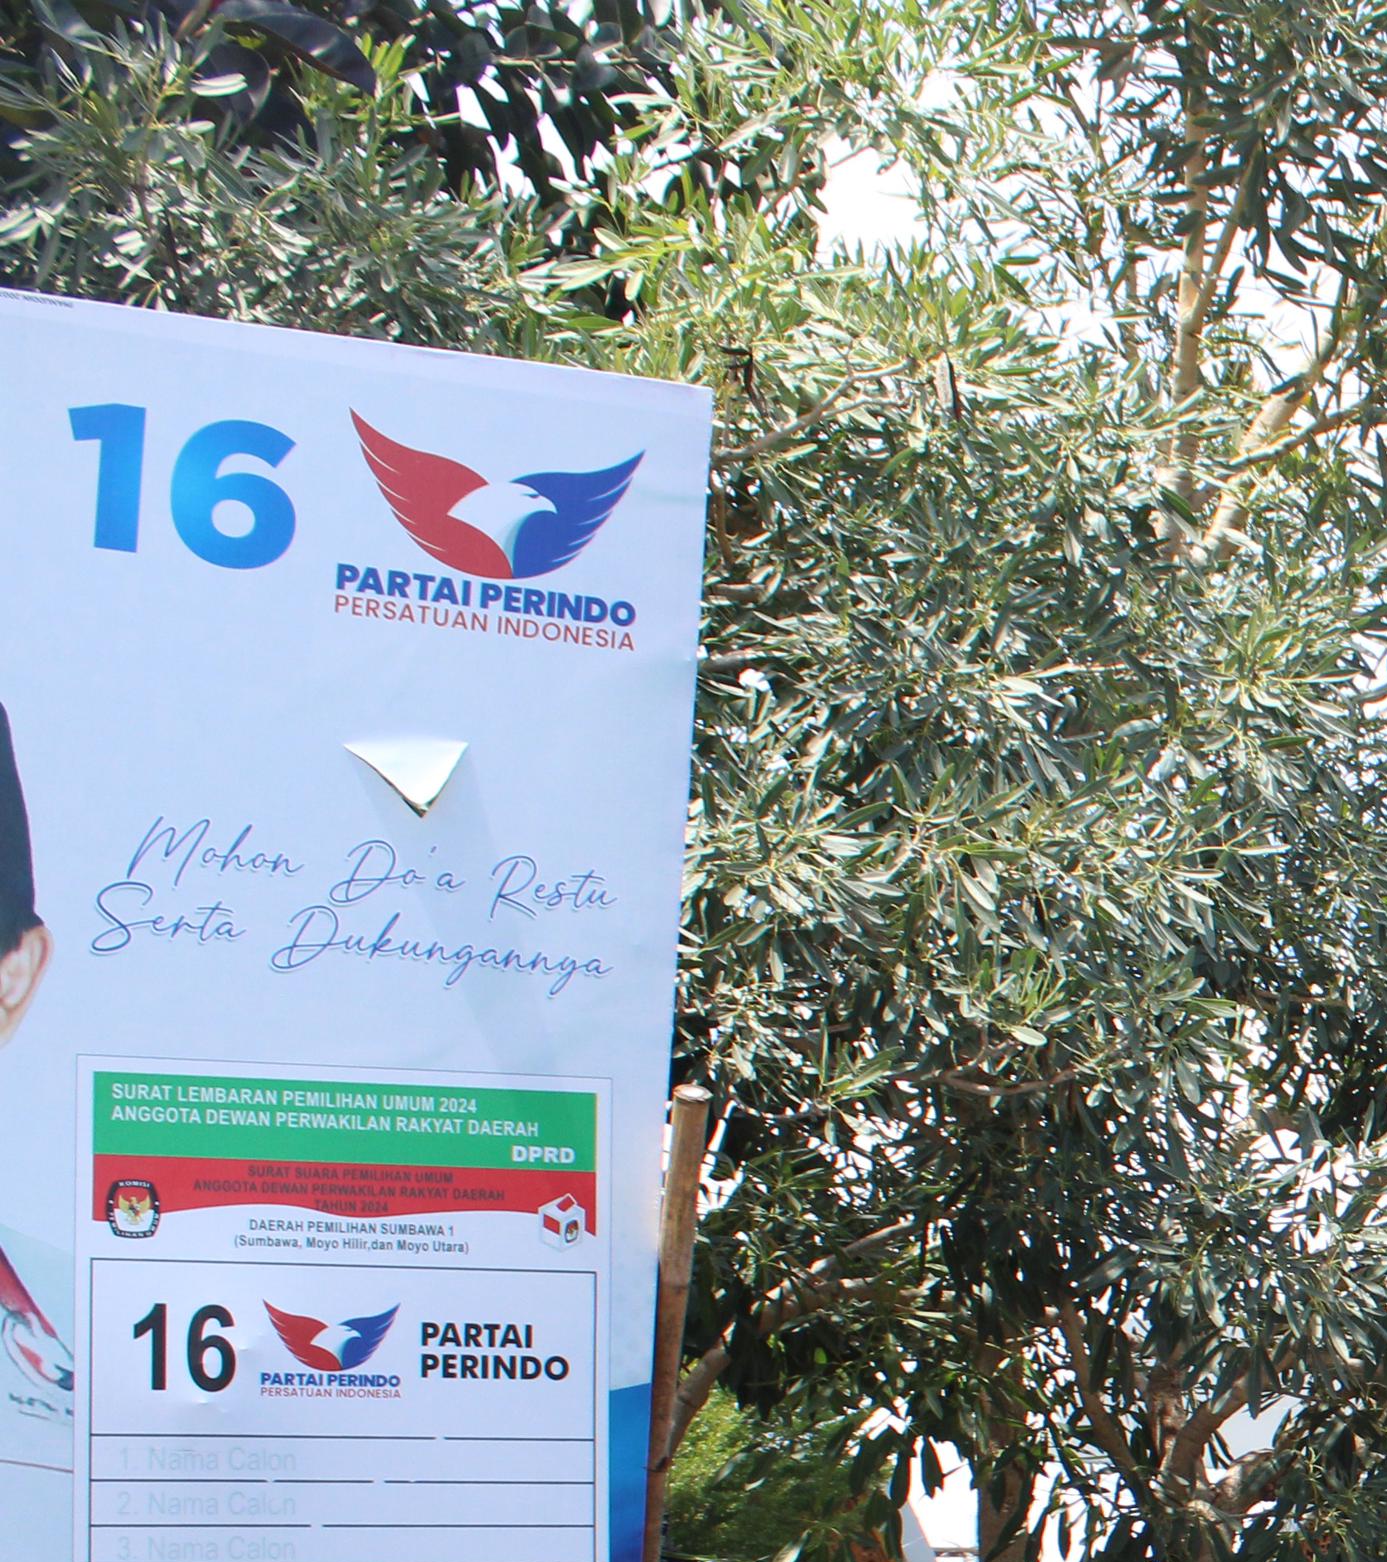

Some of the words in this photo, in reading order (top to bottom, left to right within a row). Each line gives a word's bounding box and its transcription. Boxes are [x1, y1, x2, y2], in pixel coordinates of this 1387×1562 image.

[67, 402, 297, 570] 16
[336, 562, 472, 607] PARTAI
[480, 582, 637, 627] PERINDO
[334, 594, 488, 632] PERSATUAN
[497, 615, 636, 651] INDONESIA
[127, 815, 304, 888] Mohon
[489, 855, 618, 920] Restu
[90, 881, 246, 954] Serta
[271, 904, 614, 997] Dukungannya
[111, 1083, 172, 1101] SURAT
[176, 1085, 278, 1106] LEMBARAN
[282, 1090, 377, 1111] PEMILIHAN
[383, 1095, 435, 1112] UMUM
[439, 1097, 477, 1114] 2024
[111, 1105, 201, 1125] ANGGOTA
[205, 1108, 270, 1127] DEWAN
[276, 1111, 391, 1132] PERWAKILAN
[395, 1116, 464, 1136] RAKYAT
[468, 1119, 539, 1137] DAERAH
[511, 1145, 576, 1164] DPRD
[247, 1165, 291, 1179] SURAT
[294, 1166, 338, 1180] SUARA
[342, 1168, 412, 1184] PEMILIHAN
[415, 1170, 454, 1185] UMUM
[192, 1179, 258, 1194] ANGGOTA
[261, 1180, 308, 1195] DEWAN
[311, 1182, 396, 1198] PERWAKILAN
[400, 1186, 449, 1200] RAKYAT
[452, 1188, 506, 1201] DAERAH
[248, 1219, 304, 1233] DAERAH
[307, 1220, 378, 1235] PEMILIHAN
[380, 1223, 446, 1237] SUMBAWA
[449, 1225, 455, 1237] 1
[233, 1234, 303, 1250] (Sumbawa,
[306, 1236, 340, 1252] Moyo
[396, 1239, 430, 1255] Moyo
[433, 1241, 470, 1256] Utara)
[132, 1302, 238, 1393] 16
[420, 1322, 534, 1349] PARTAI
[260, 1372, 323, 1387] PARTAI
[327, 1373, 401, 1388] PERINDO
[420, 1353, 571, 1382] PERINDO
[259, 1386, 333, 1399] PERSATUAN
[335, 1387, 401, 1400] INDONESIA
